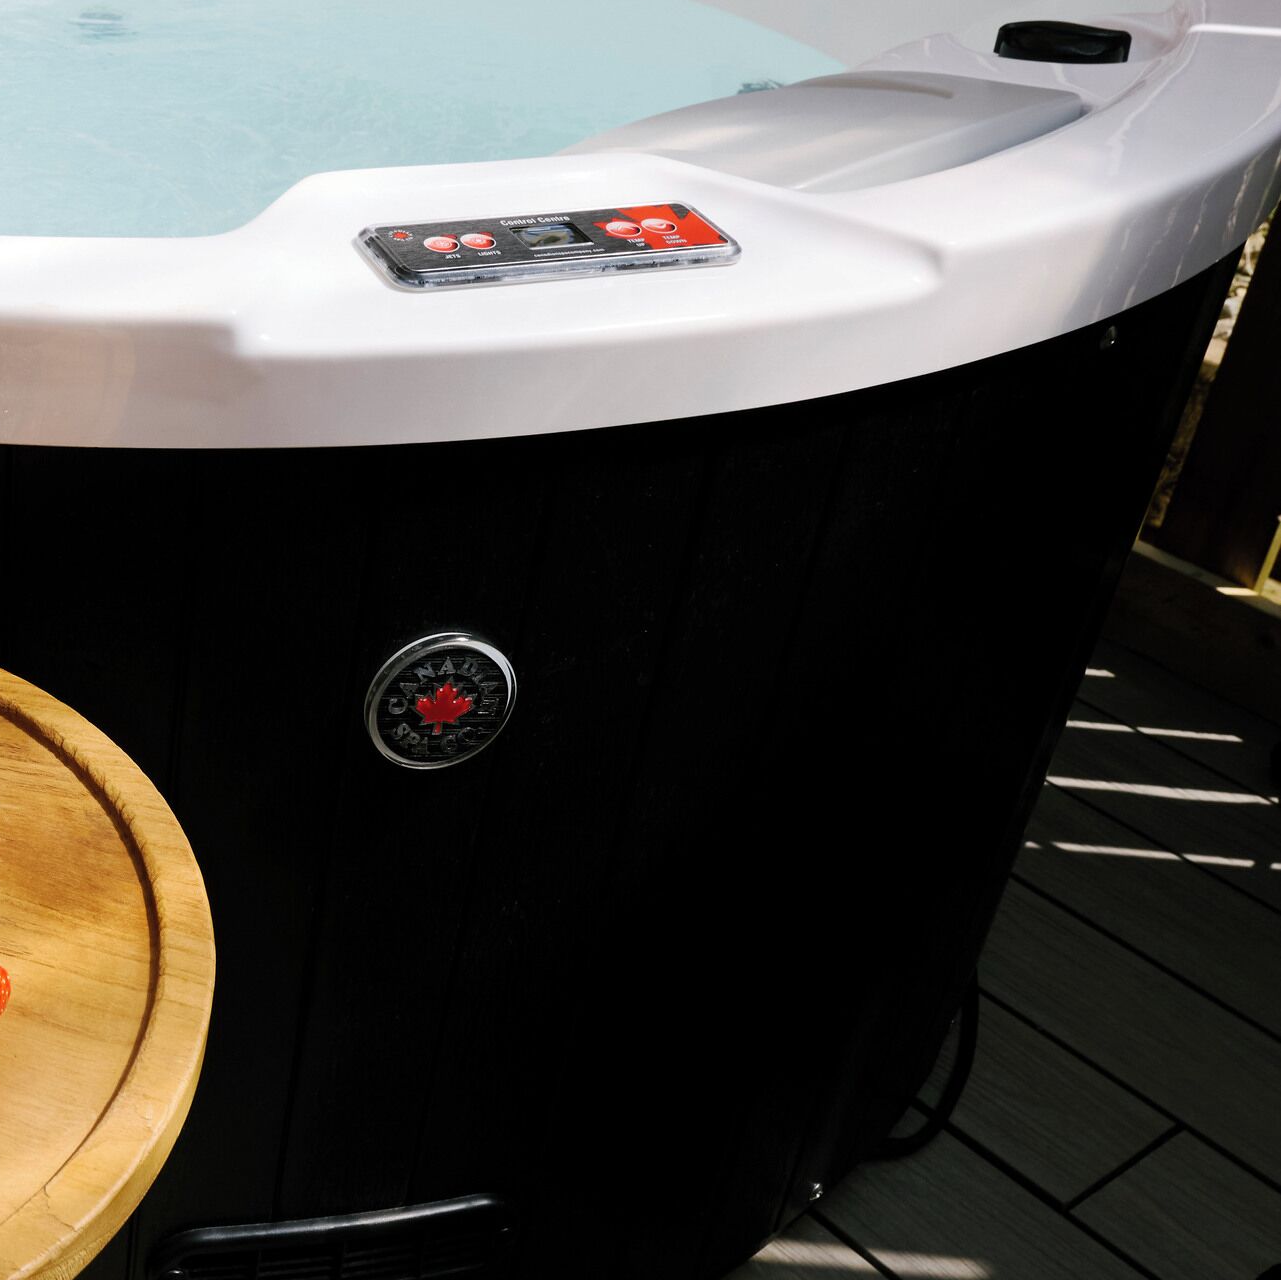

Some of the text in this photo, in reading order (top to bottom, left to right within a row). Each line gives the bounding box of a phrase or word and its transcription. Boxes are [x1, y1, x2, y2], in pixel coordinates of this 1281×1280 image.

[500, 215, 570, 226] Control Centre
[388, 656, 499, 716] CANADIAN
